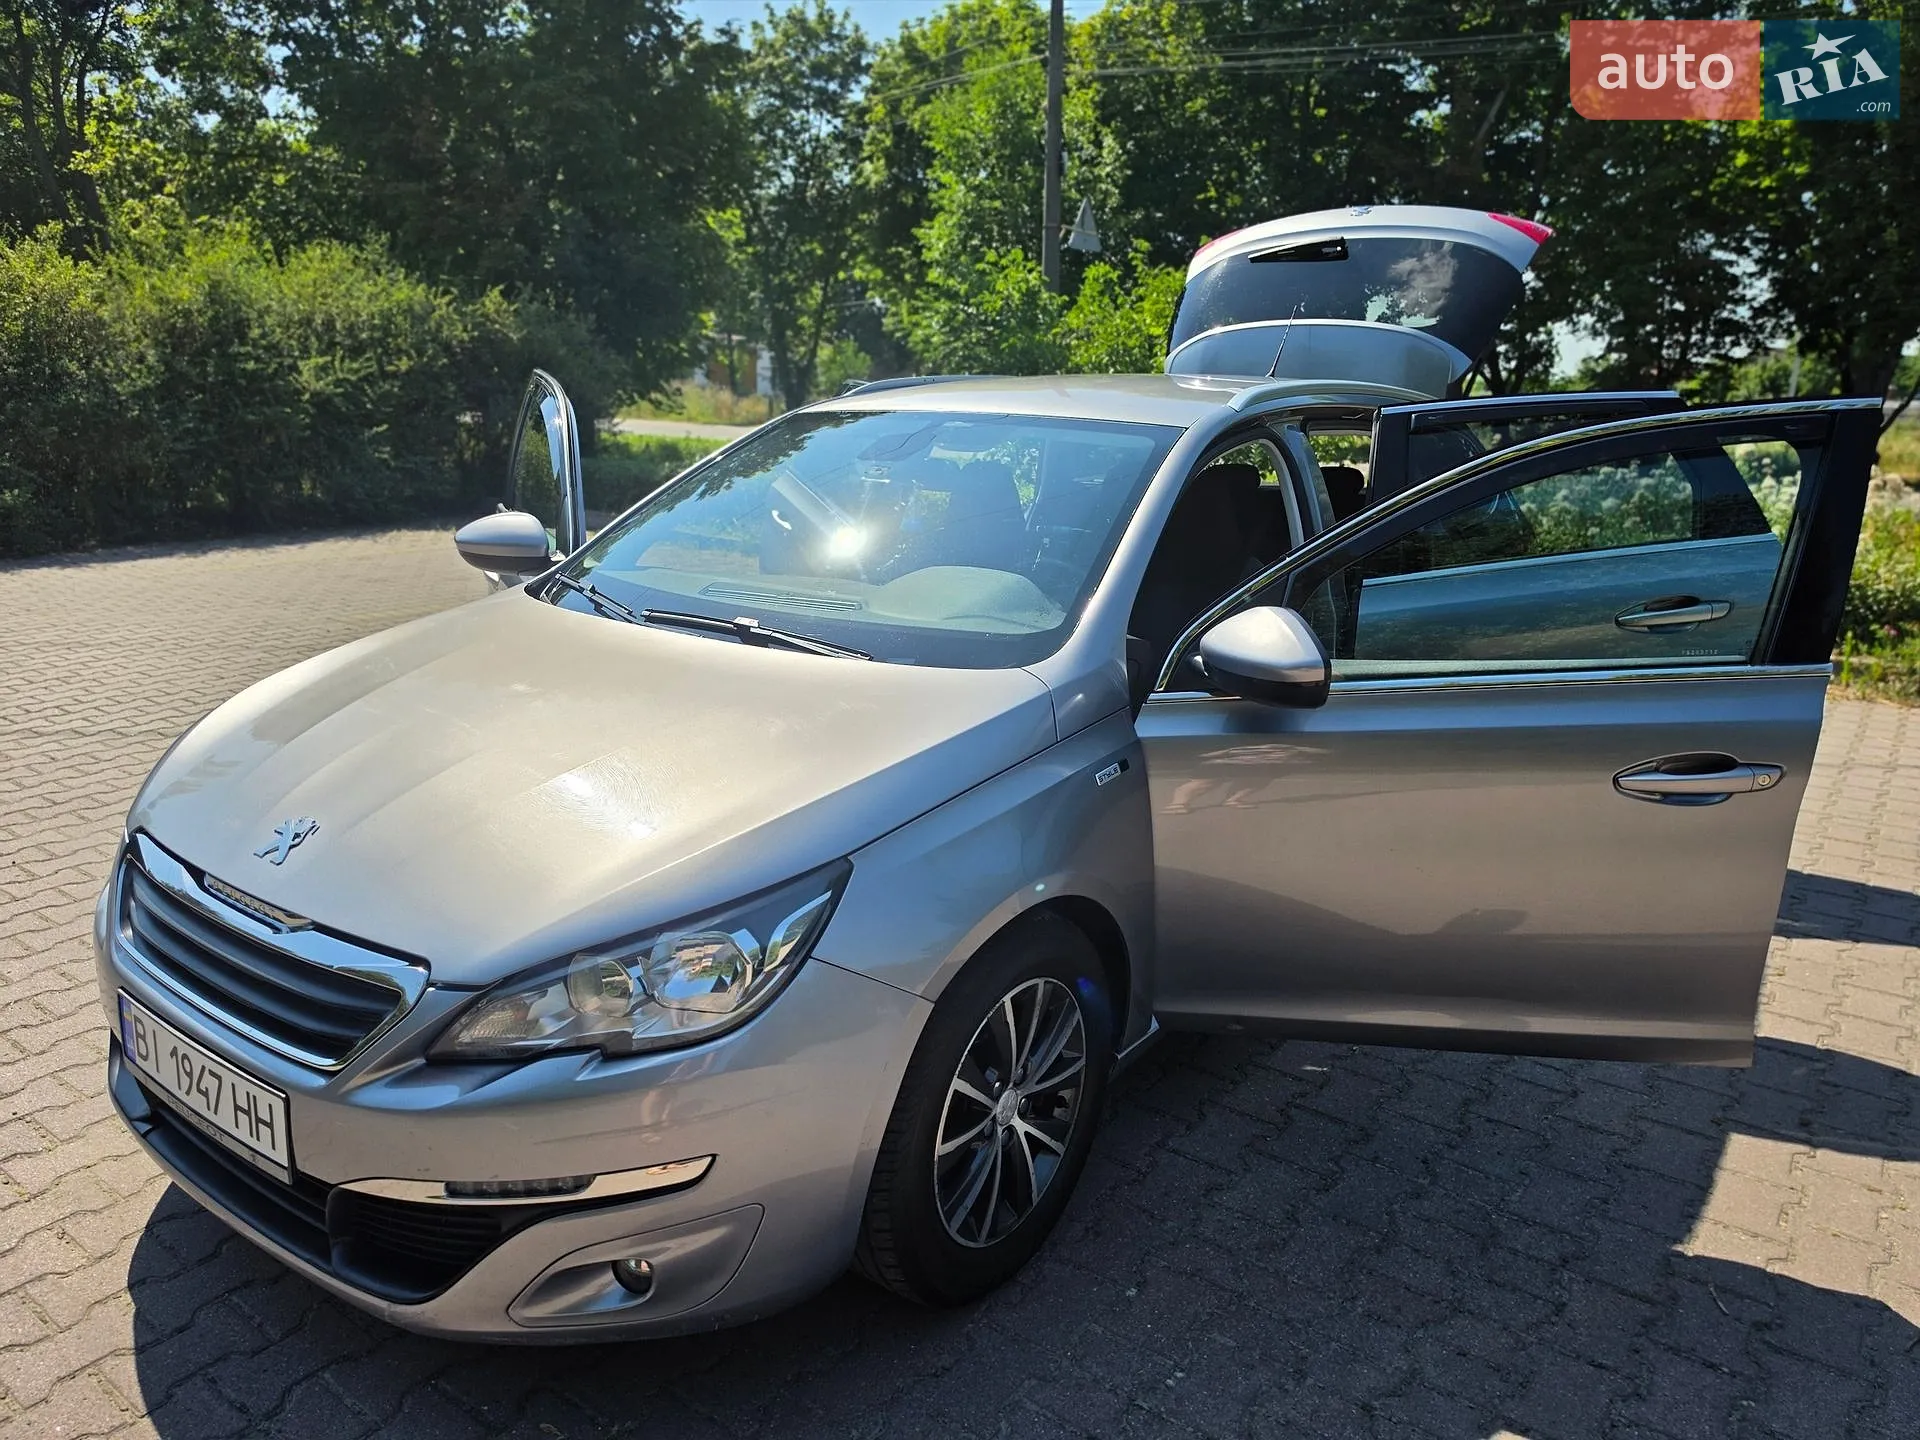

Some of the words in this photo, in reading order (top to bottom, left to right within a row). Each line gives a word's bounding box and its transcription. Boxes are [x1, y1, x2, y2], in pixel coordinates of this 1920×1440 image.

[133, 1014, 161, 1074] BI
[170, 1045, 223, 1116] 1947
[231, 1081, 276, 1151] HH
